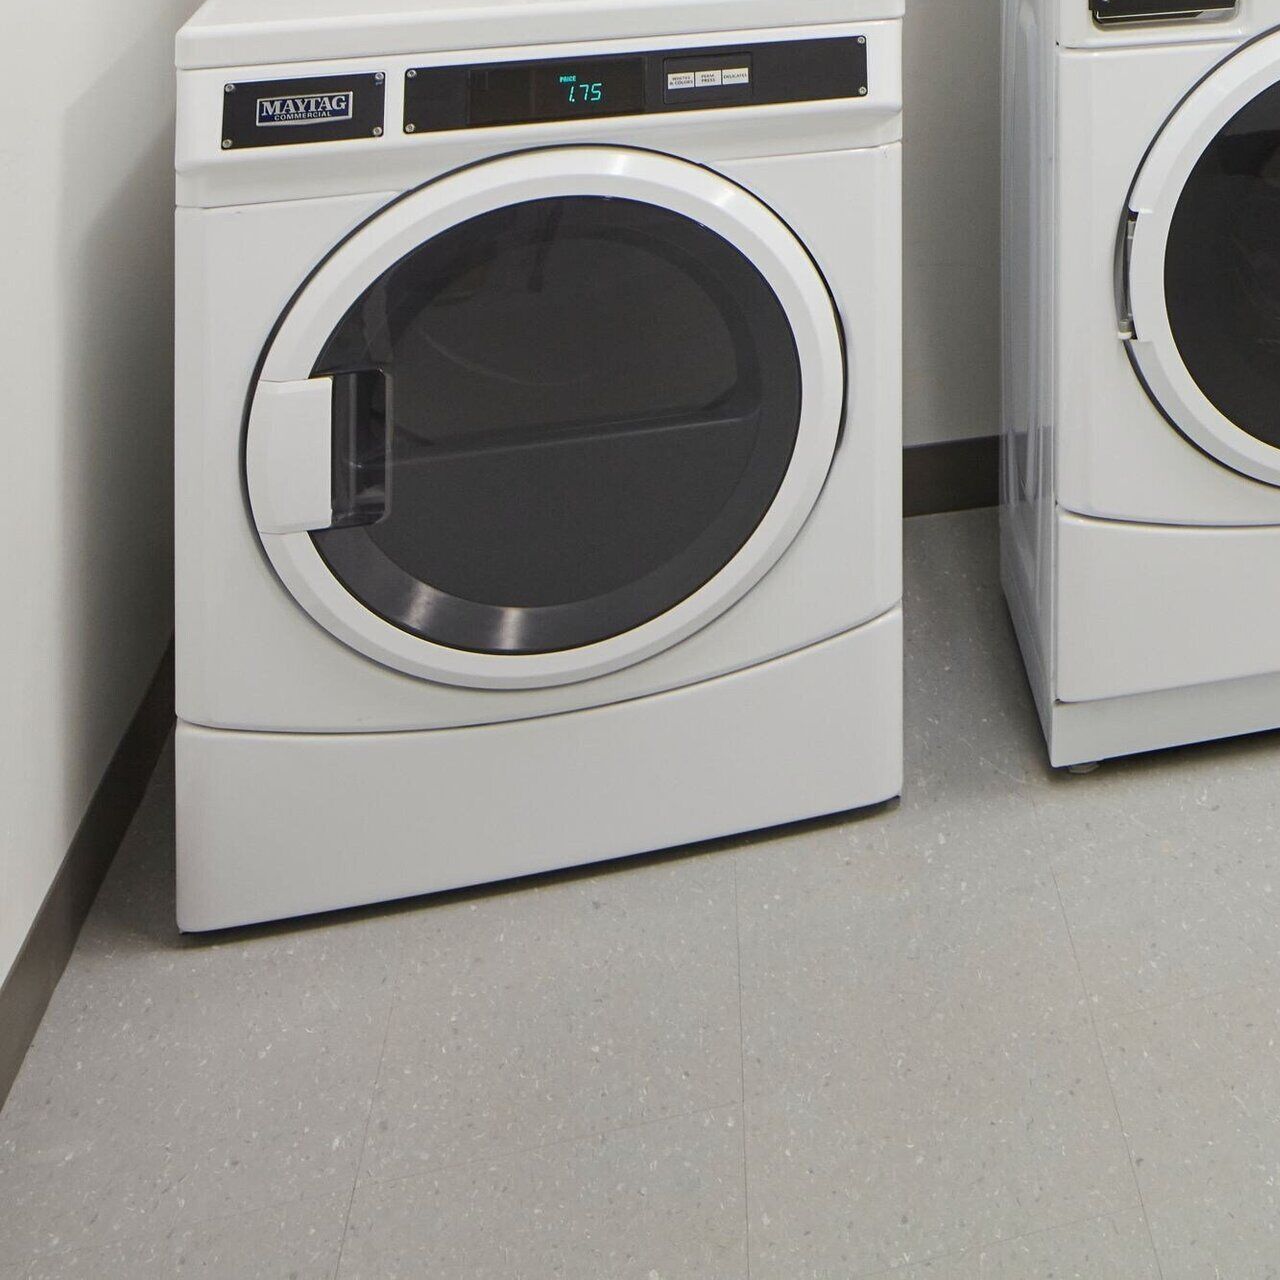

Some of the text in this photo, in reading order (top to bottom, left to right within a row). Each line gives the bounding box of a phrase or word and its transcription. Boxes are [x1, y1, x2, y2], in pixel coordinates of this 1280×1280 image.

[559, 75, 577, 83] PRICE
[568, 82, 602, 102] 1.75
[261, 95, 347, 116] MAYTAG
[274, 111, 332, 121] COMMERCIAL
